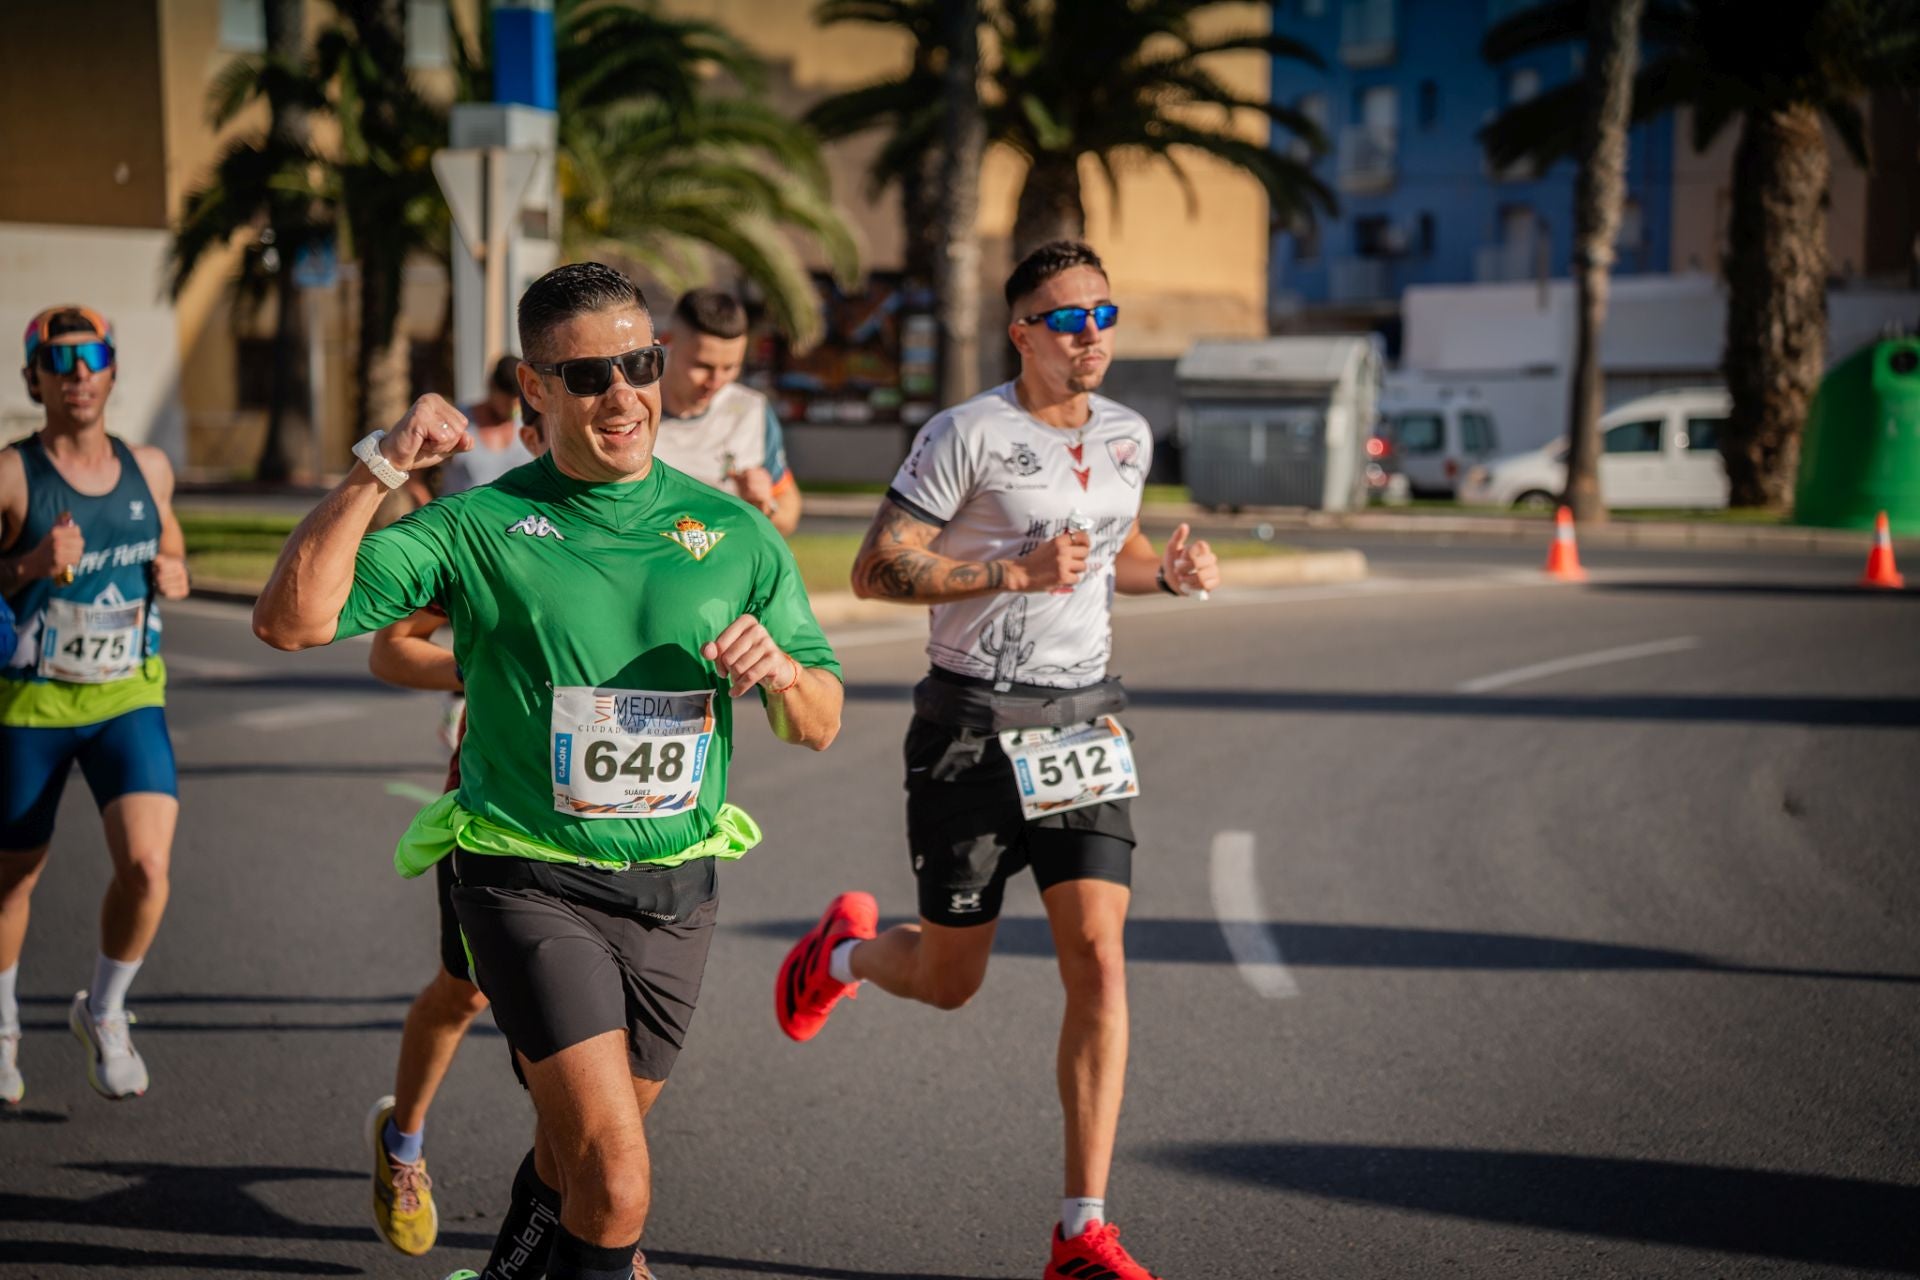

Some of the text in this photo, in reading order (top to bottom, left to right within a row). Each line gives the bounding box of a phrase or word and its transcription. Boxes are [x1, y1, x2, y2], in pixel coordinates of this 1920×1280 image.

[63, 634, 125, 662] 475
[613, 696, 673, 717] MEDIA
[578, 724, 621, 734] CIUDAD
[559, 746, 567, 777] CAJÓN
[584, 740, 685, 783] 648
[1038, 746, 1112, 786] 512
